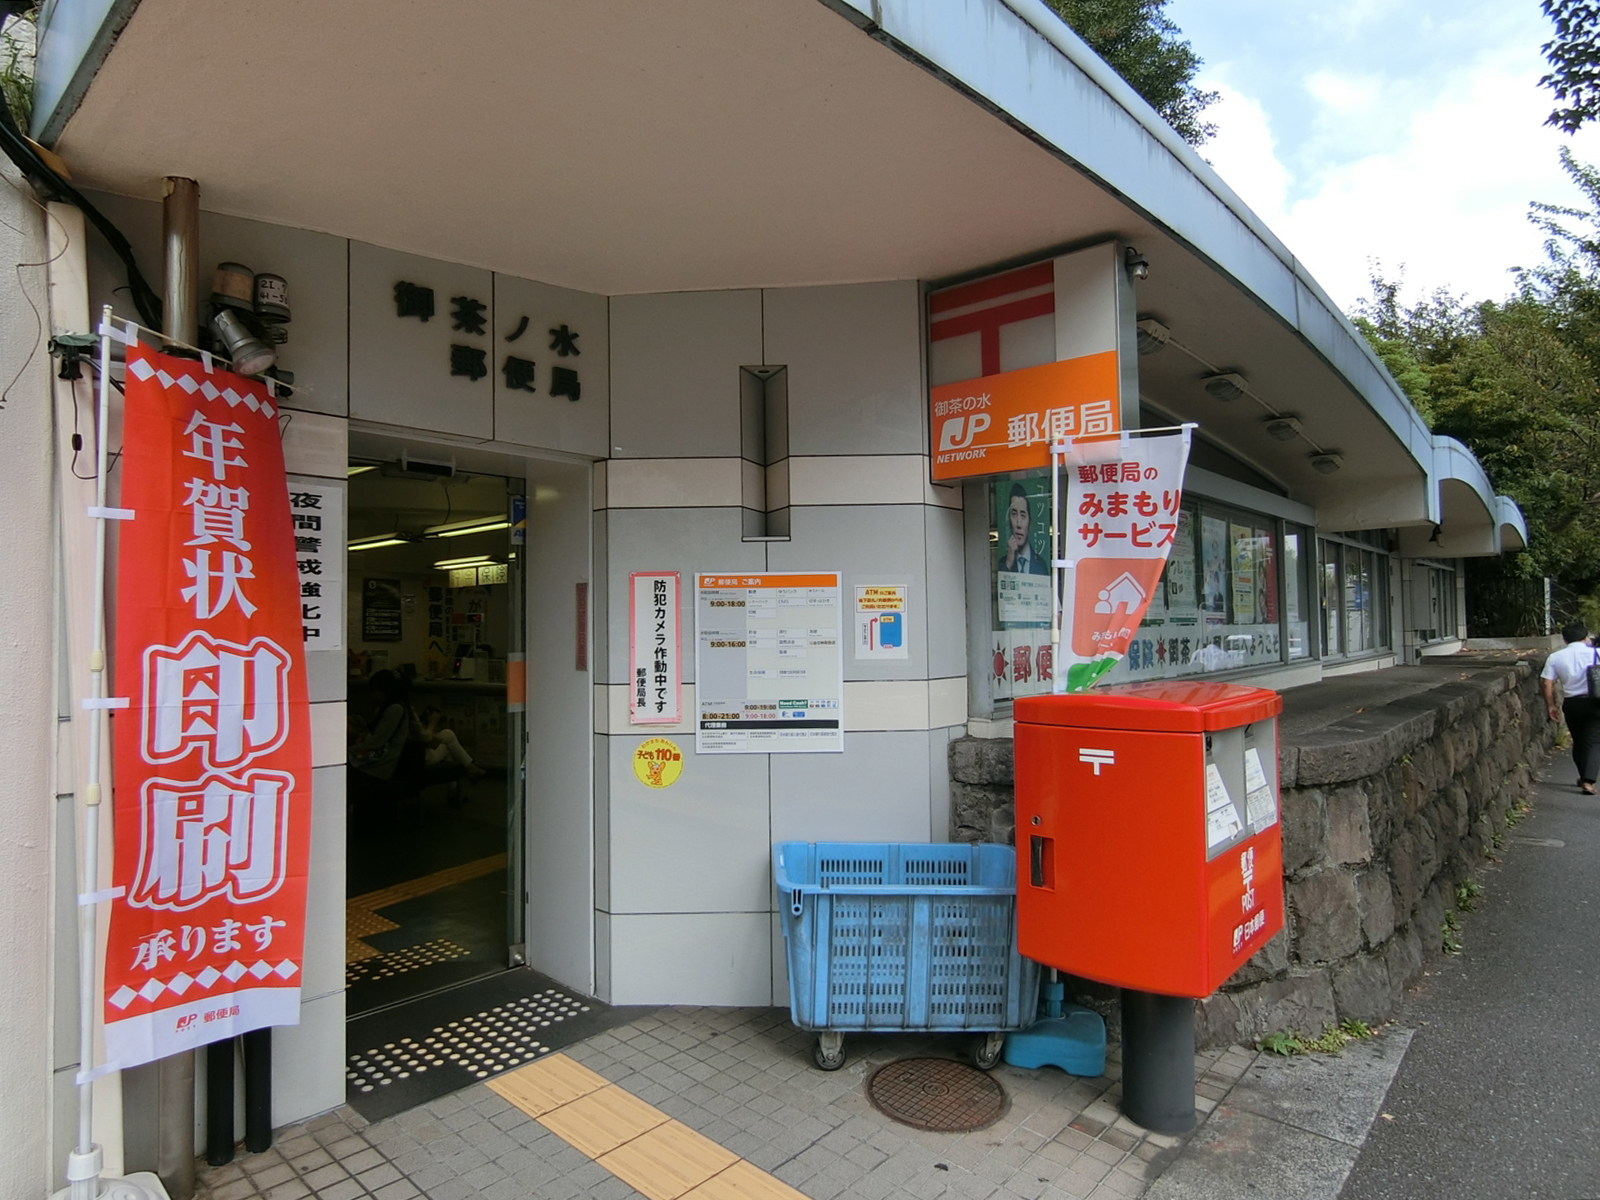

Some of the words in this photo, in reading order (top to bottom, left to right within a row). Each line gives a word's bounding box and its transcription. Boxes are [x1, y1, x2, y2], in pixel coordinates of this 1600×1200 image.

[394, 280, 581, 357] 御茶ノ水
[451, 344, 581, 401] 郵便局
[934, 393, 991, 418] 御茶の水
[1007, 400, 1113, 449] 郵便局
[936, 448, 987, 465] NETWORK
[1078, 462, 1158, 484] 郵便局の
[181, 409, 258, 619] 年賀状
[1078, 489, 1181, 518] みまもり
[1078, 522, 1178, 548] サービス
[710, 600, 746, 608] 9:00-18:00
[653, 579, 668, 714] 防犯カメラ作動中です
[710, 640, 746, 648] 9:00-16:00
[636, 667, 647, 708] 郵便局長
[131, 631, 294, 911] 印刷
[1241, 888, 1255, 914] POST
[130, 915, 286, 971] 承ります
[203, 1005, 240, 1023] 郵便局
